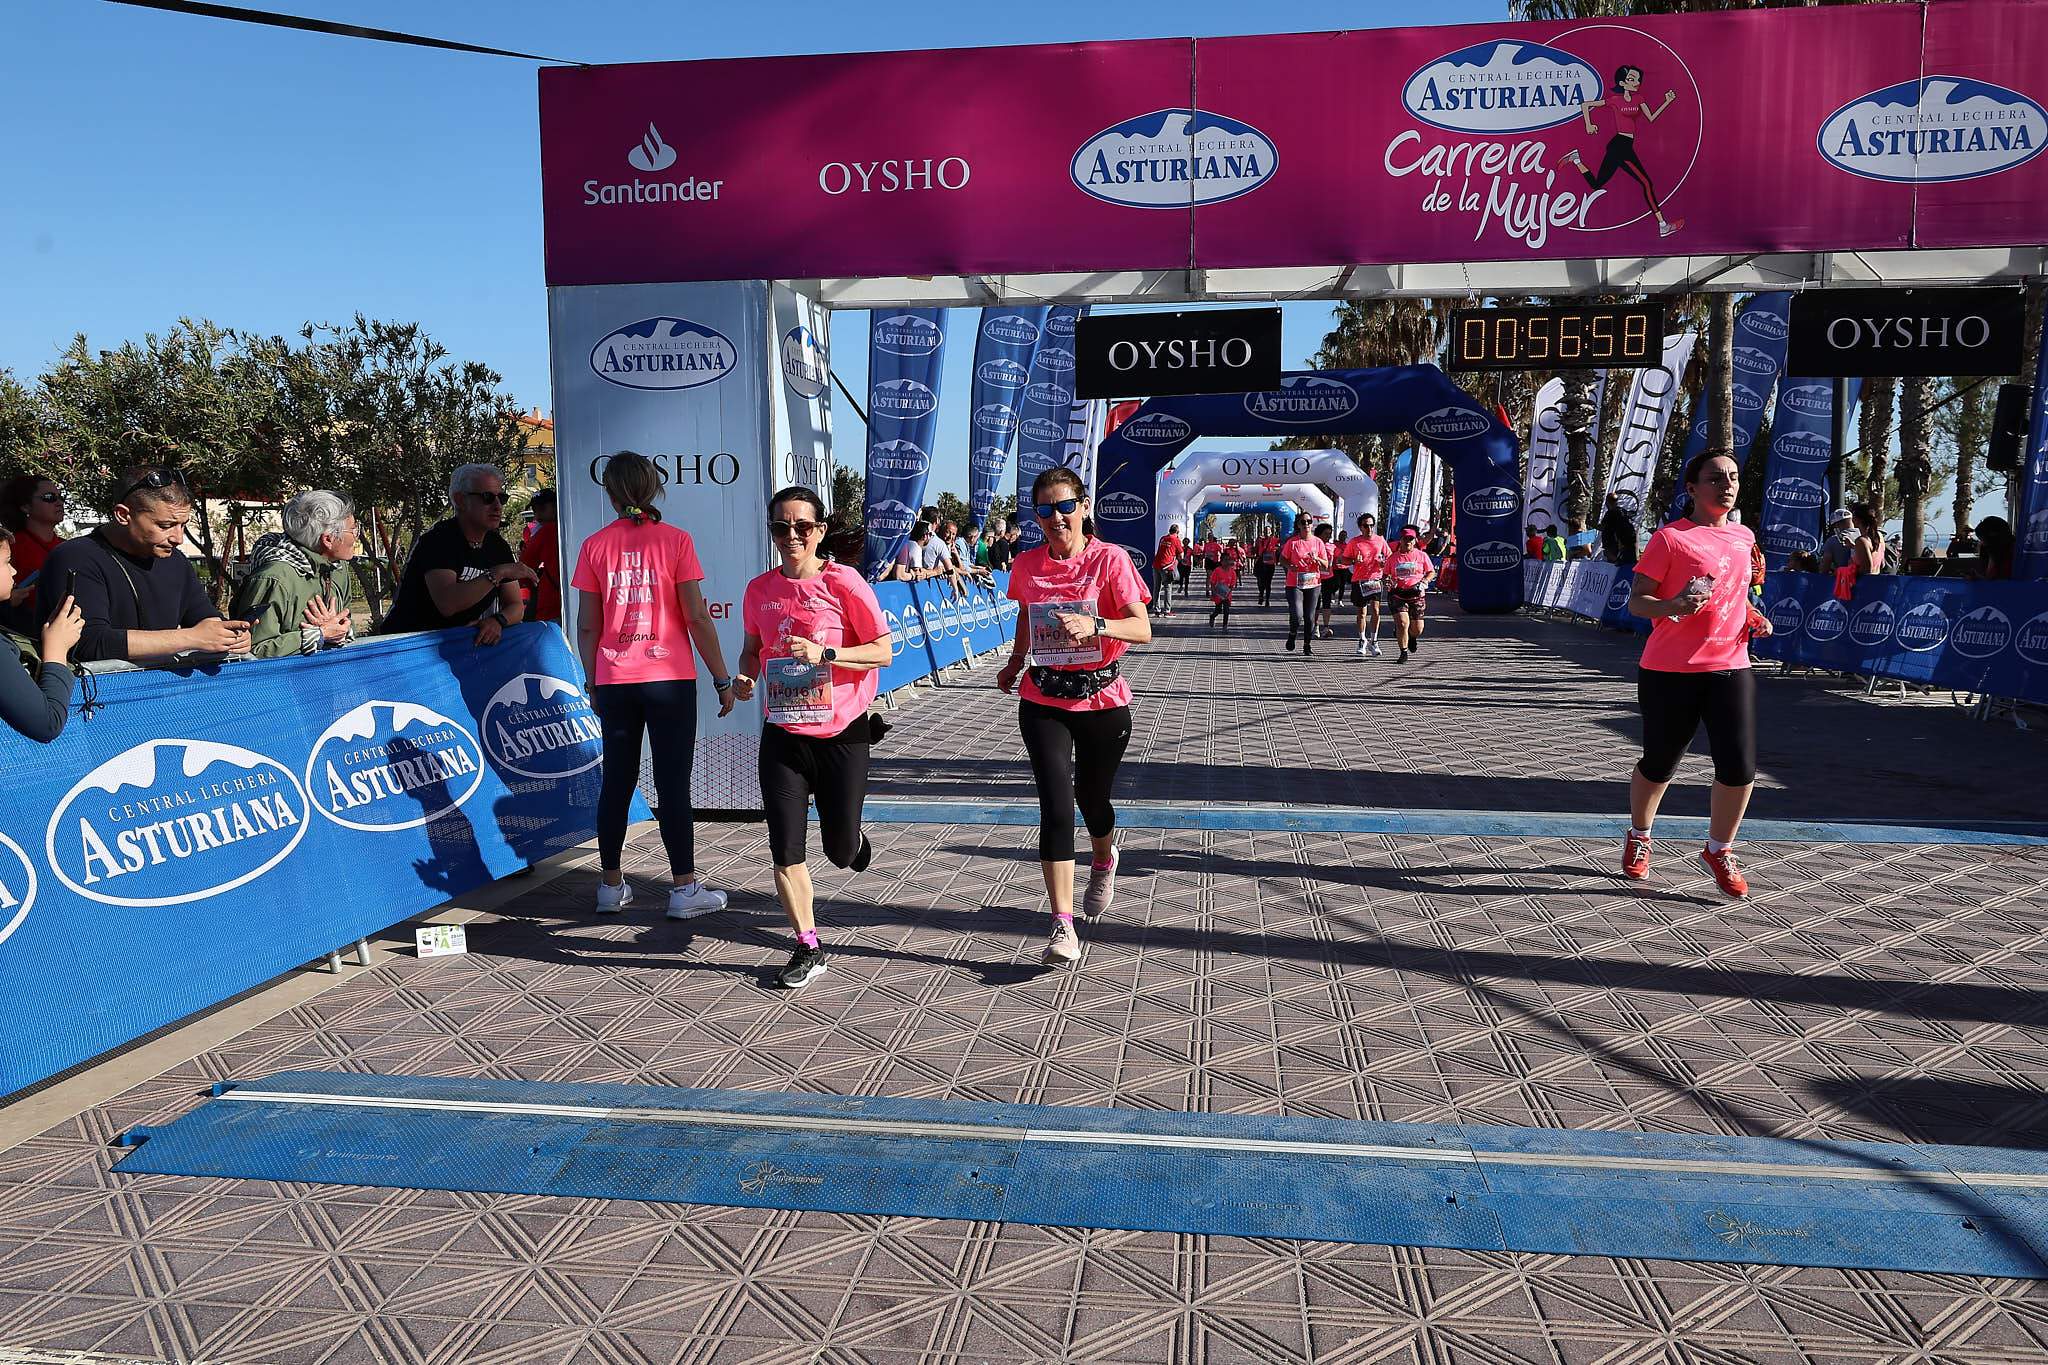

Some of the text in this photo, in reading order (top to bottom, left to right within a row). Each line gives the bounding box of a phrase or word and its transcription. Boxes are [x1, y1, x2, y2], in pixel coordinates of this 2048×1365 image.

[1448, 69, 1582, 83] CENTRAL LECHERA
[1416, 77, 1586, 111] ASTURIANA
[1871, 109, 2028, 125] CENTRAL LECHERA
[1118, 143, 1183, 155] CENTRAL
[1834, 118, 2034, 156] ASTURIANA
[1086, 149, 1263, 184] ASTURIANA
[1384, 130, 1546, 177] Carrera
[818, 157, 971, 195] OYSHO
[583, 176, 724, 205] Santander
[1422, 170, 1607, 249] de la Mujer
[623, 340, 721, 350] CENTRAL LECHERA
[1463, 315, 1647, 360] 00:56:58
[1827, 316, 1990, 349] OYSHO
[601, 346, 727, 373] ASTURIANA
[1108, 338, 1252, 371] OYSHO
[1734, 355, 1772, 372] STURIANA
[1253, 392, 1350, 412] ASTURIANA
[1787, 393, 1832, 411] ASTURIA
[1126, 424, 1185, 438] ASTURIANA
[1421, 420, 1486, 433] ASTURIANA
[589, 453, 740, 487] OSHO
[785, 453, 828, 488] OYSHO
[1222, 458, 1310, 476] OYSHO
[1348, 511, 1365, 519] OYS
[622, 551, 641, 567] TU
[608, 569, 658, 588] DORSAL
[1898, 618, 1944, 641] ASTURIANA
[1954, 624, 2005, 646] ASTURIANA
[508, 709, 550, 725] CENTRAL
[344, 729, 457, 766] CENTRAL LECHERA
[326, 745, 478, 814] ASTURIANA
[108, 771, 278, 823] CENTRAL LECHERA
[79, 791, 300, 885] ASTURIANA
